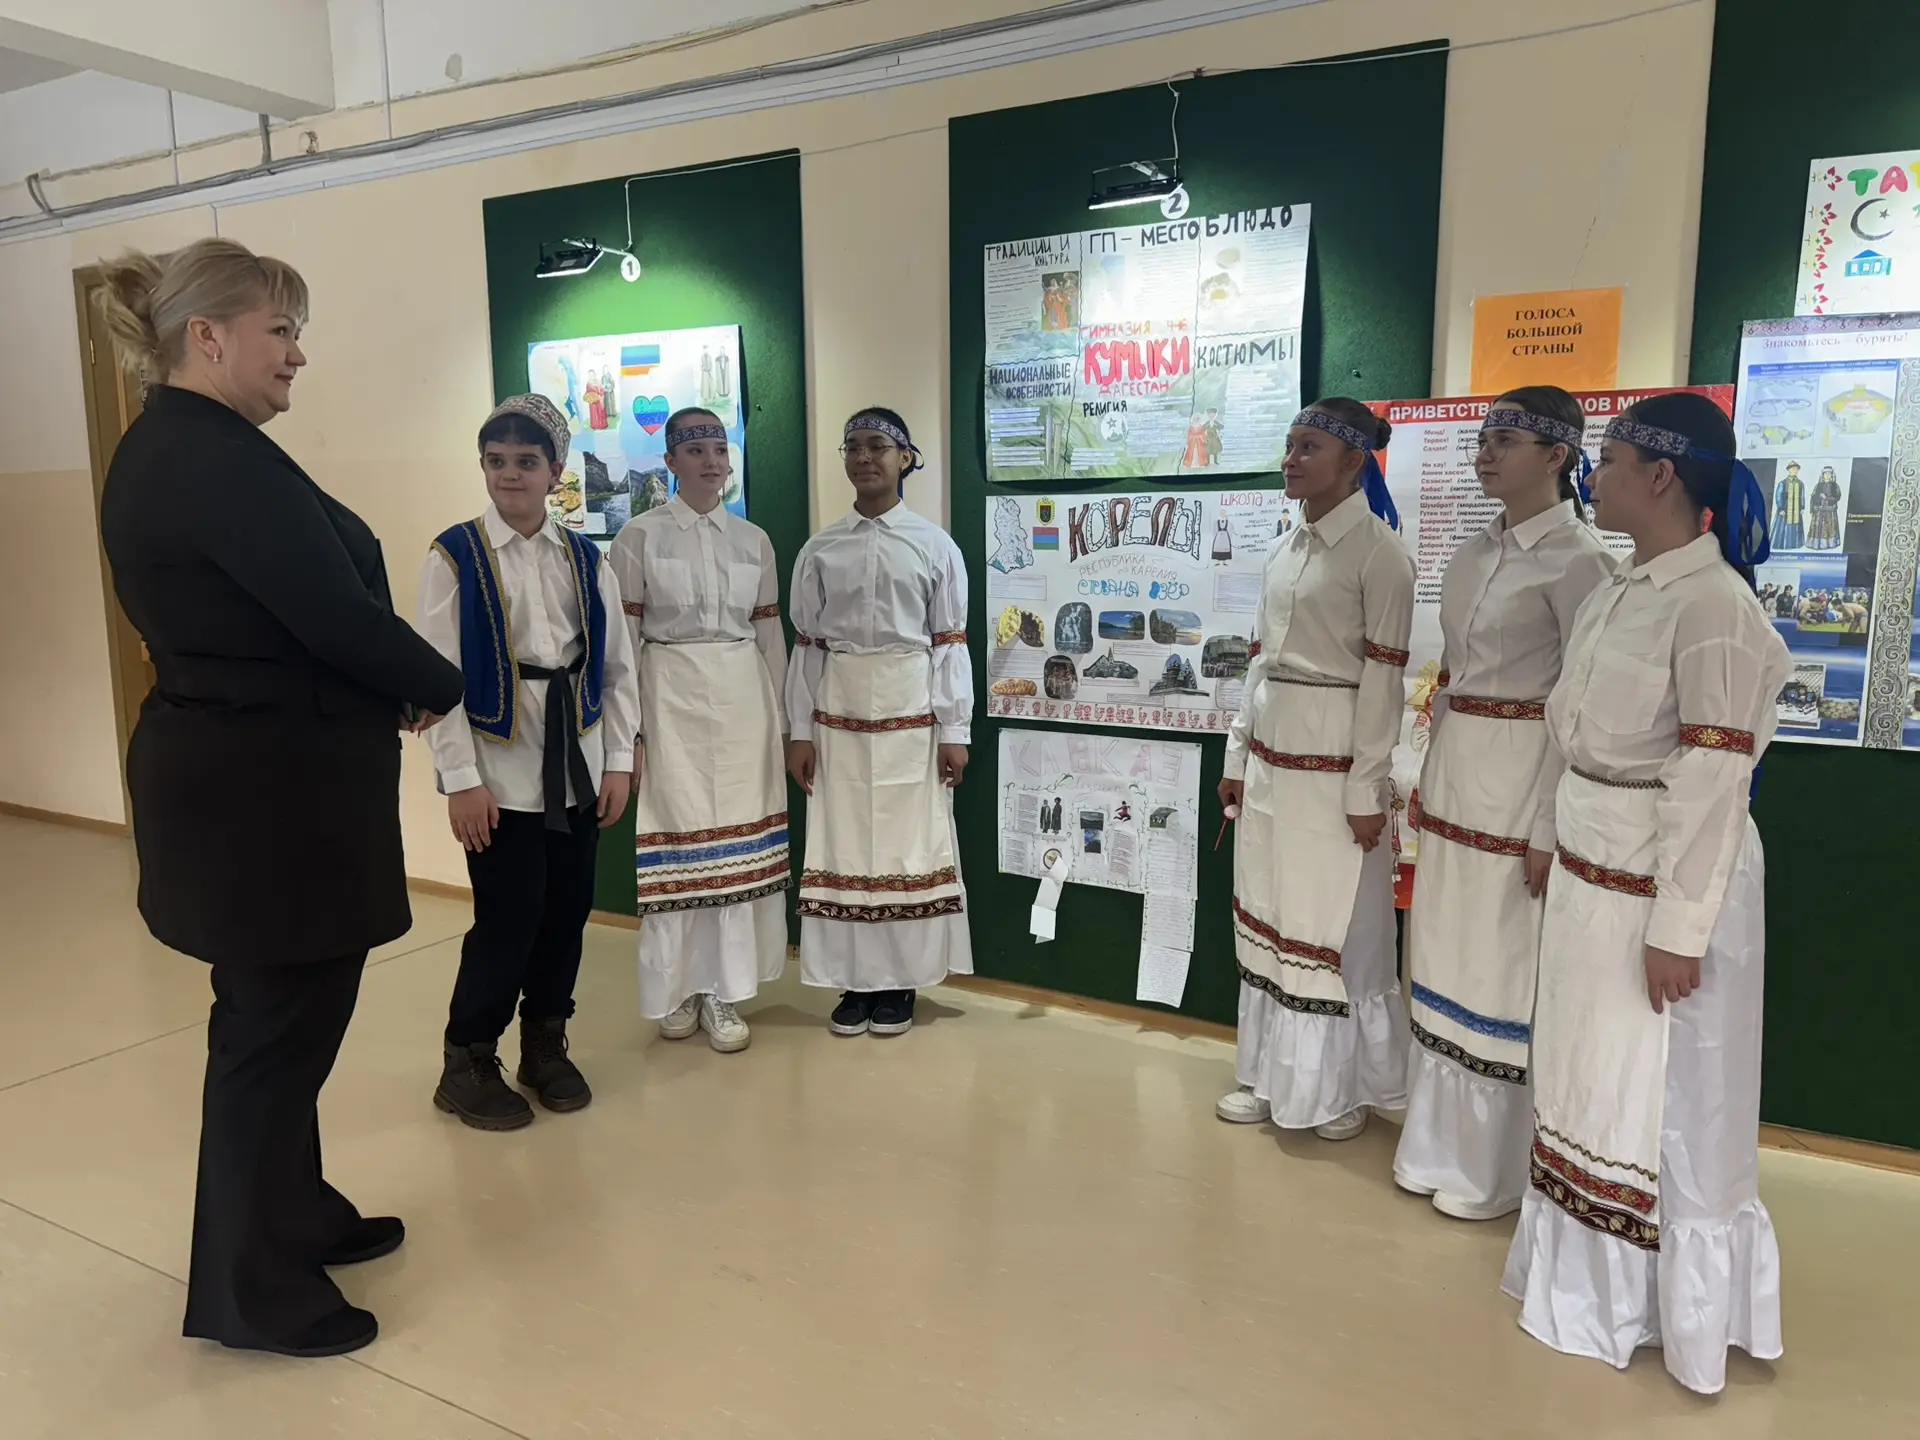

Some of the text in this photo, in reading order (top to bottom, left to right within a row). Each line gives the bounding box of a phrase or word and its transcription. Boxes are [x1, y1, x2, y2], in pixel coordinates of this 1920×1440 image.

[1168, 194, 1182, 213] 2
[1206, 205, 1293, 237] БЛЮДО
[1090, 232, 1116, 253] ГП
[1141, 220, 1200, 247] МЕСТО
[986, 235, 1070, 261] ТРАДИЦИИ И
[626, 261, 634, 276] 1
[1515, 308, 1576, 321] ГОЛОСА
[1081, 320, 1151, 339] ГИМНАЗИЯ
[1506, 322, 1583, 339] БОЛЬШОЙ
[1512, 342, 1575, 356] СТРАНЫ
[1763, 332, 1908, 349] Знакомьтесь буряты!
[1084, 336, 1190, 385] КУМЫКИ
[1197, 336, 1294, 368] КОСТЮМЫ
[990, 362, 1071, 385] НАЦИОНАЛЬНЫЕ
[1006, 382, 1071, 399] ОСОБЕННОСТИ
[1099, 380, 1169, 397] ДАГЕСТАН
[1083, 400, 1127, 417] РЕЛИГИЯ
[1390, 401, 1494, 420] ПРИВЕТСТВ
[1080, 554, 1146, 578] РЕСПУБЛИКА
[1131, 565, 1178, 581] КАРЕЛИЯ
[1009, 736, 1183, 786] КАВКАЗ
